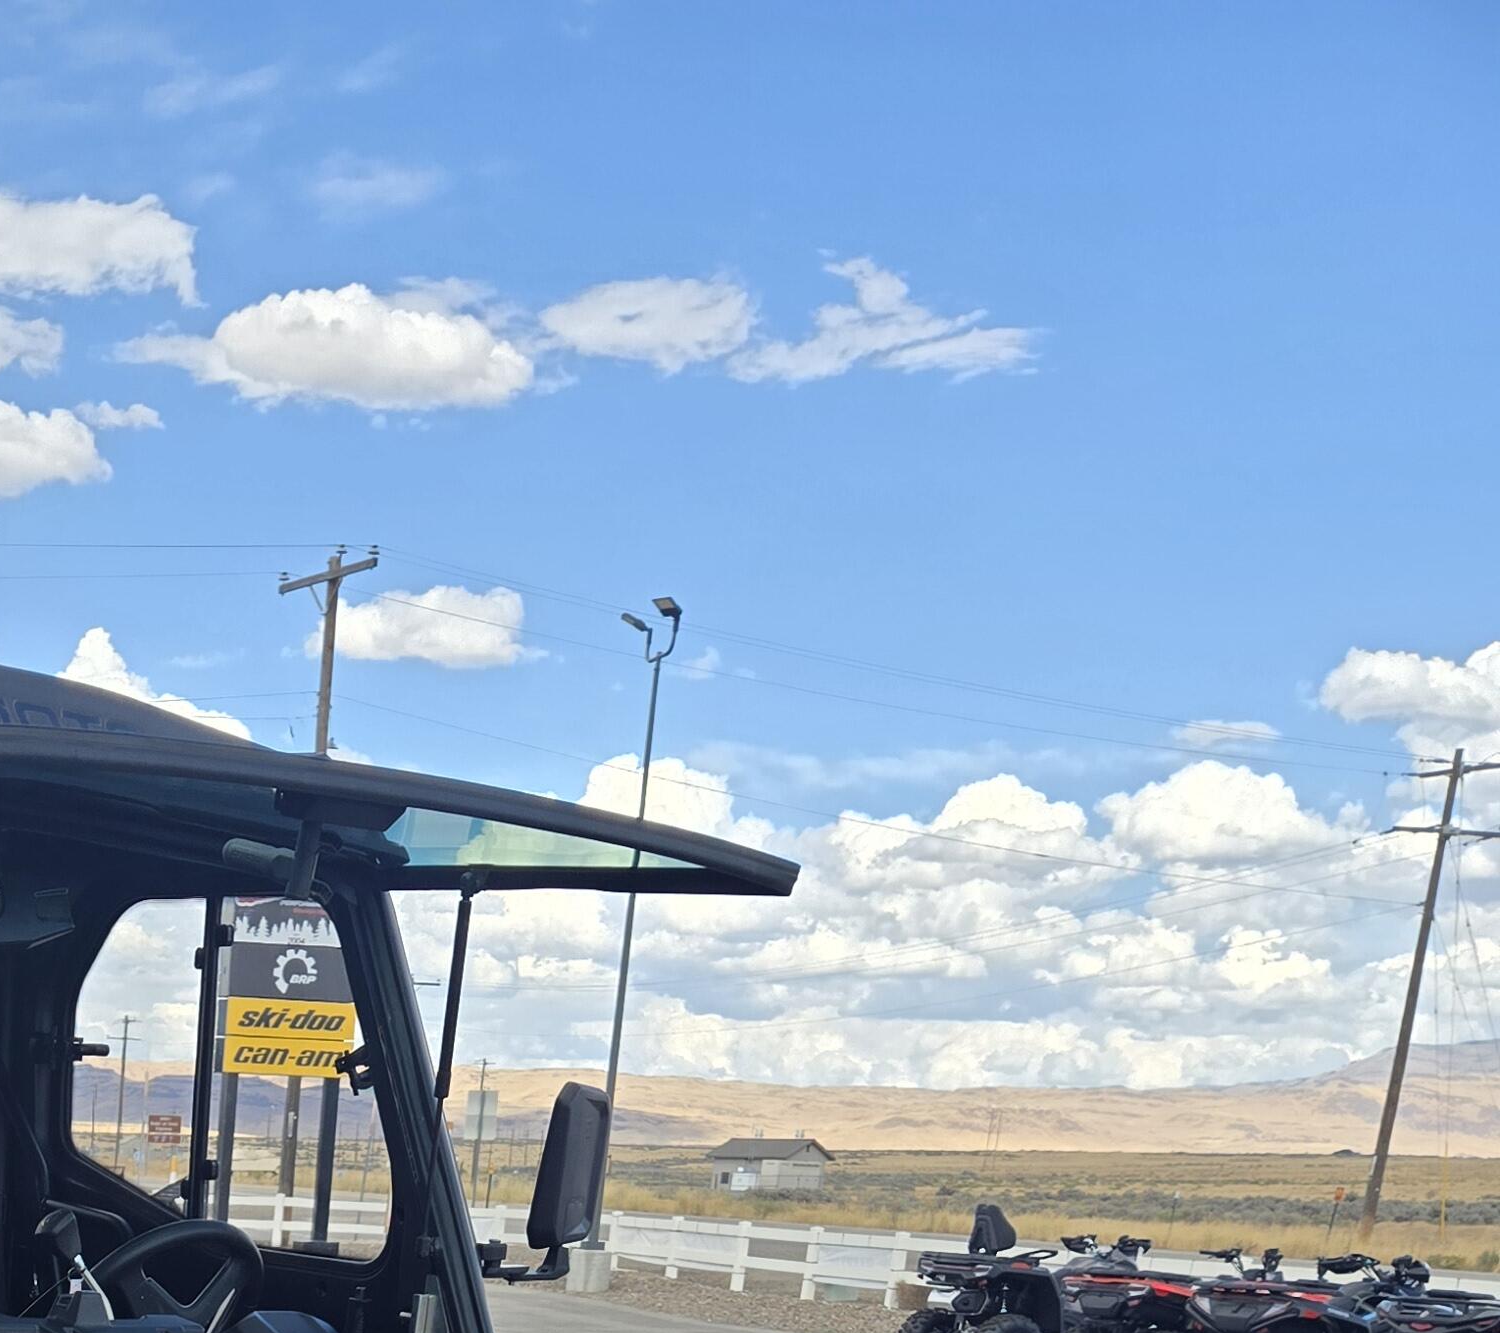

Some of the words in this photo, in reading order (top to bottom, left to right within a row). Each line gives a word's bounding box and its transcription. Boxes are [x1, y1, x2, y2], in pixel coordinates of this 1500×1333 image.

[289, 974, 317, 985] BRP
[238, 1007, 345, 1031] ski-doo
[233, 1046, 343, 1067] can-am
